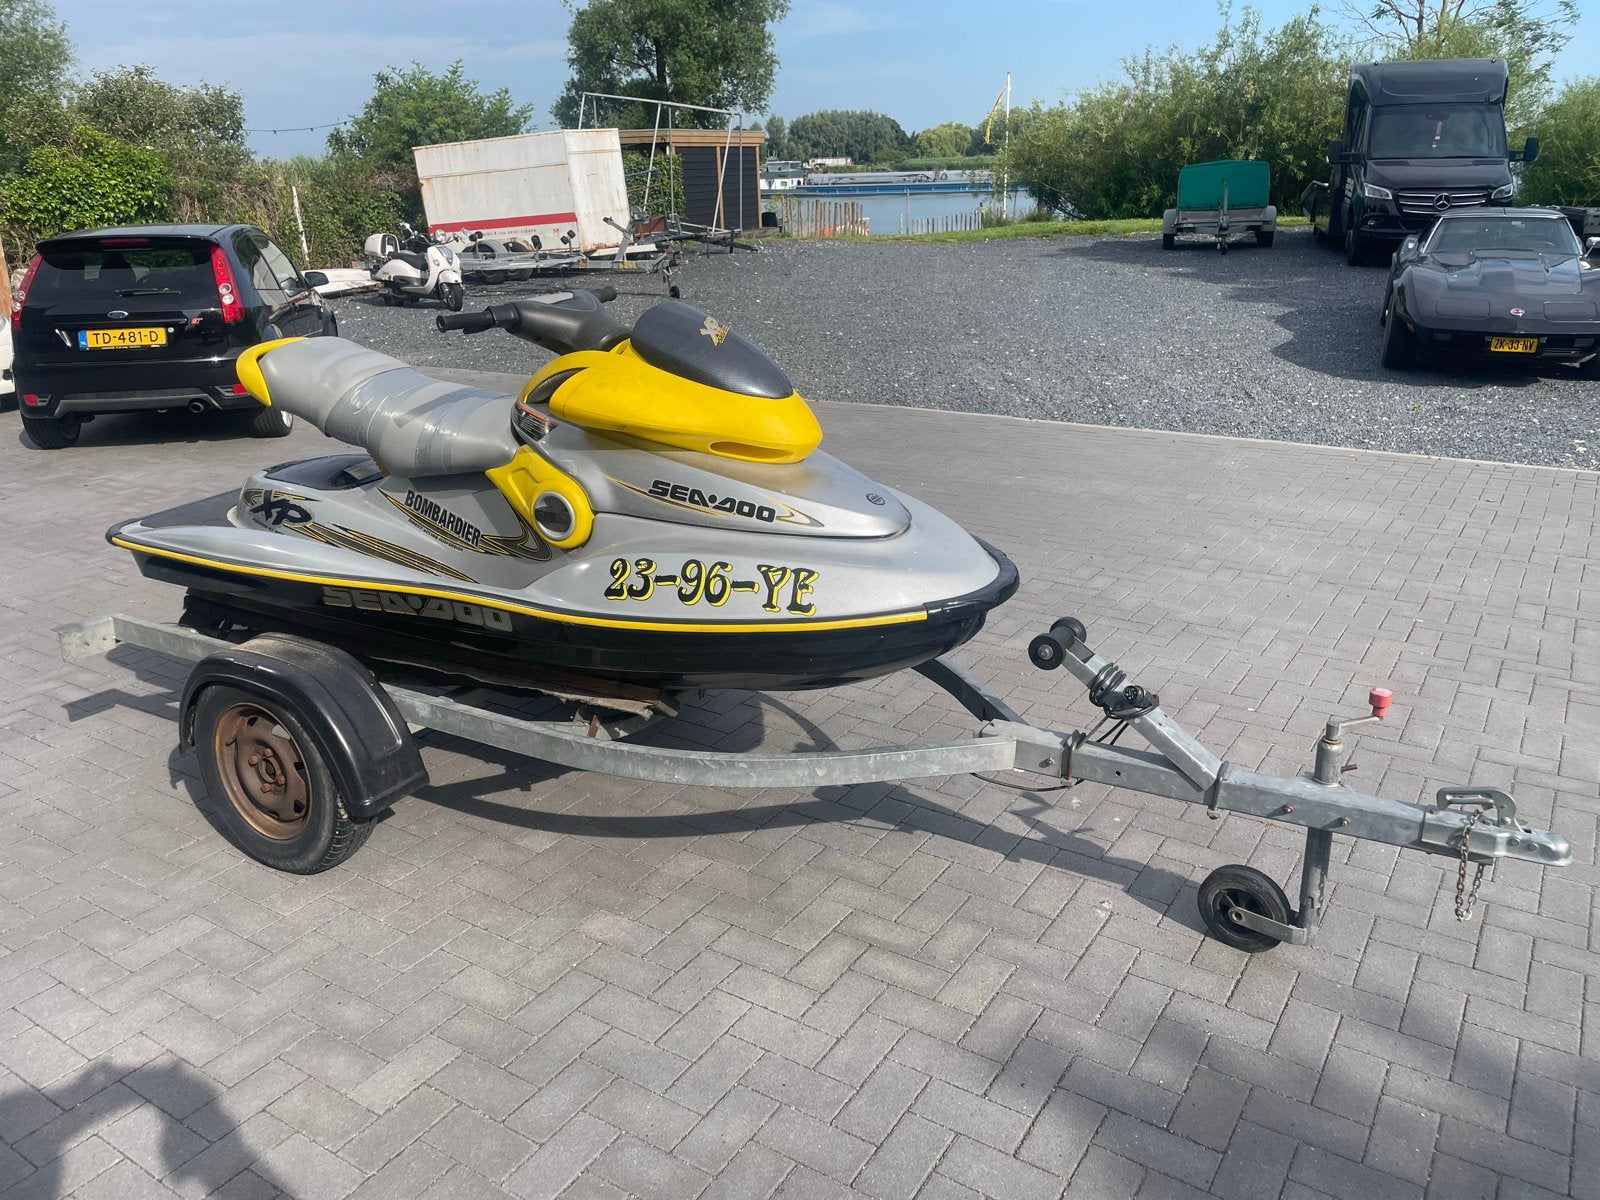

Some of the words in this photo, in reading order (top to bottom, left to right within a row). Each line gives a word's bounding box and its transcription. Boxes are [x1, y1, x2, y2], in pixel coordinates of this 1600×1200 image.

[93, 330, 159, 345] TD-481-D
[1494, 338, 1535, 351] ZK-33-NY
[249, 489, 313, 526] XP
[404, 489, 482, 547] BOMBARDIER
[604, 557, 820, 617] 23-96-YE
